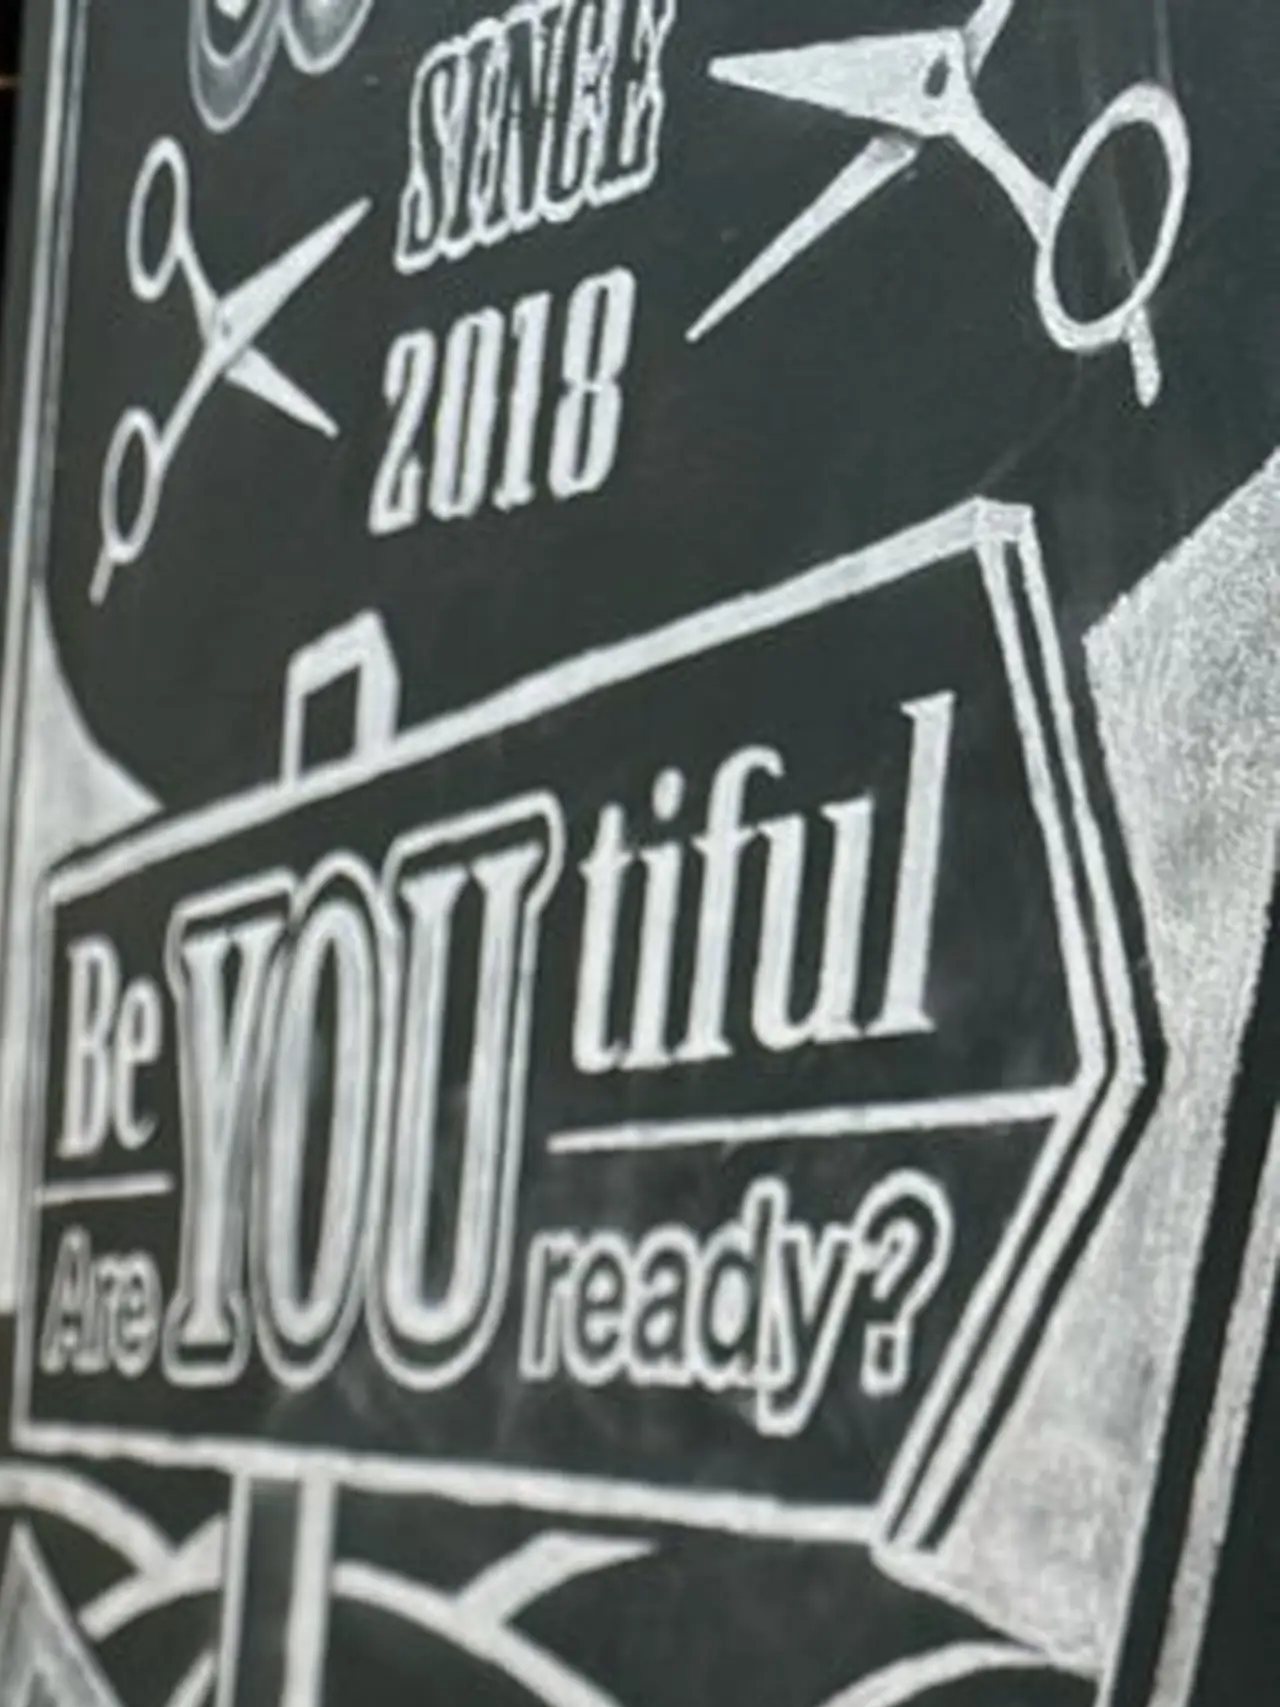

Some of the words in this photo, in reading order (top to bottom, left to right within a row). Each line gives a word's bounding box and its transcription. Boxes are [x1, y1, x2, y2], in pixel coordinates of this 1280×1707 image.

[367, 268, 634, 535] 2018
[57, 937, 160, 1160] Be
[164, 792, 566, 1389] YOU
[572, 692, 955, 1073] tiful
[41, 1228, 163, 1377] Are
[519, 1171, 953, 1435] ready?
